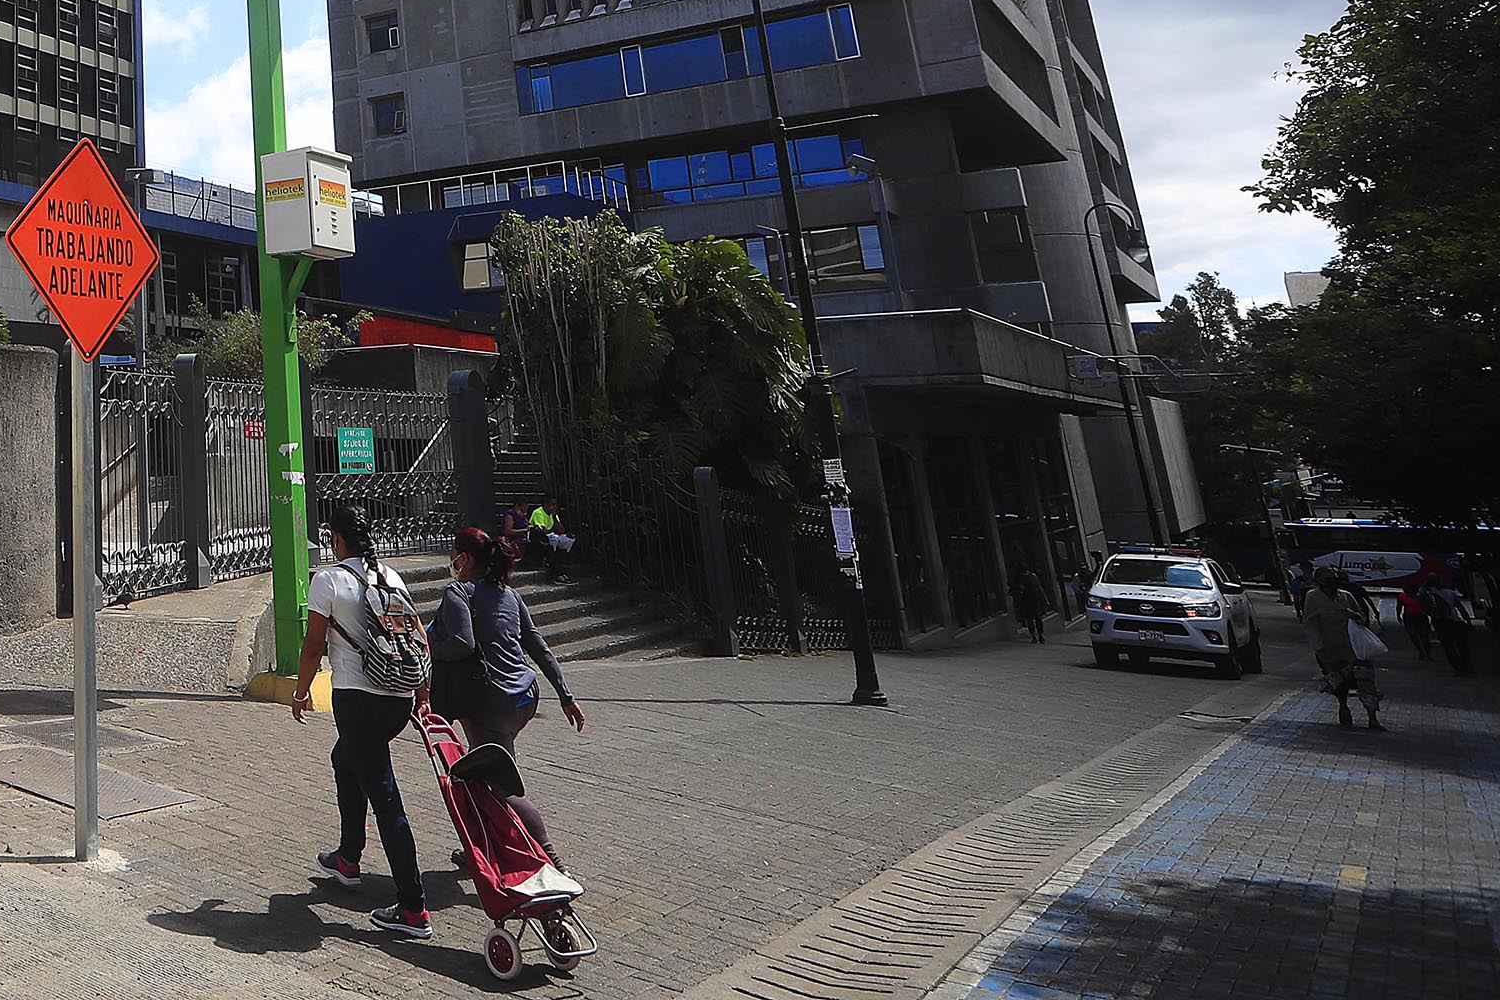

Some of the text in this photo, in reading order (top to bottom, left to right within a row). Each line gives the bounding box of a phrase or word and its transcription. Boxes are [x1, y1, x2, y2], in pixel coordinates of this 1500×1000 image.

[265, 184, 304, 197] heliotek
[319, 186, 346, 201] heliotek
[47, 198, 123, 231] MAQUINARIA
[36, 227, 134, 267] TRABAJANDO
[49, 265, 124, 300] ADELANTE
